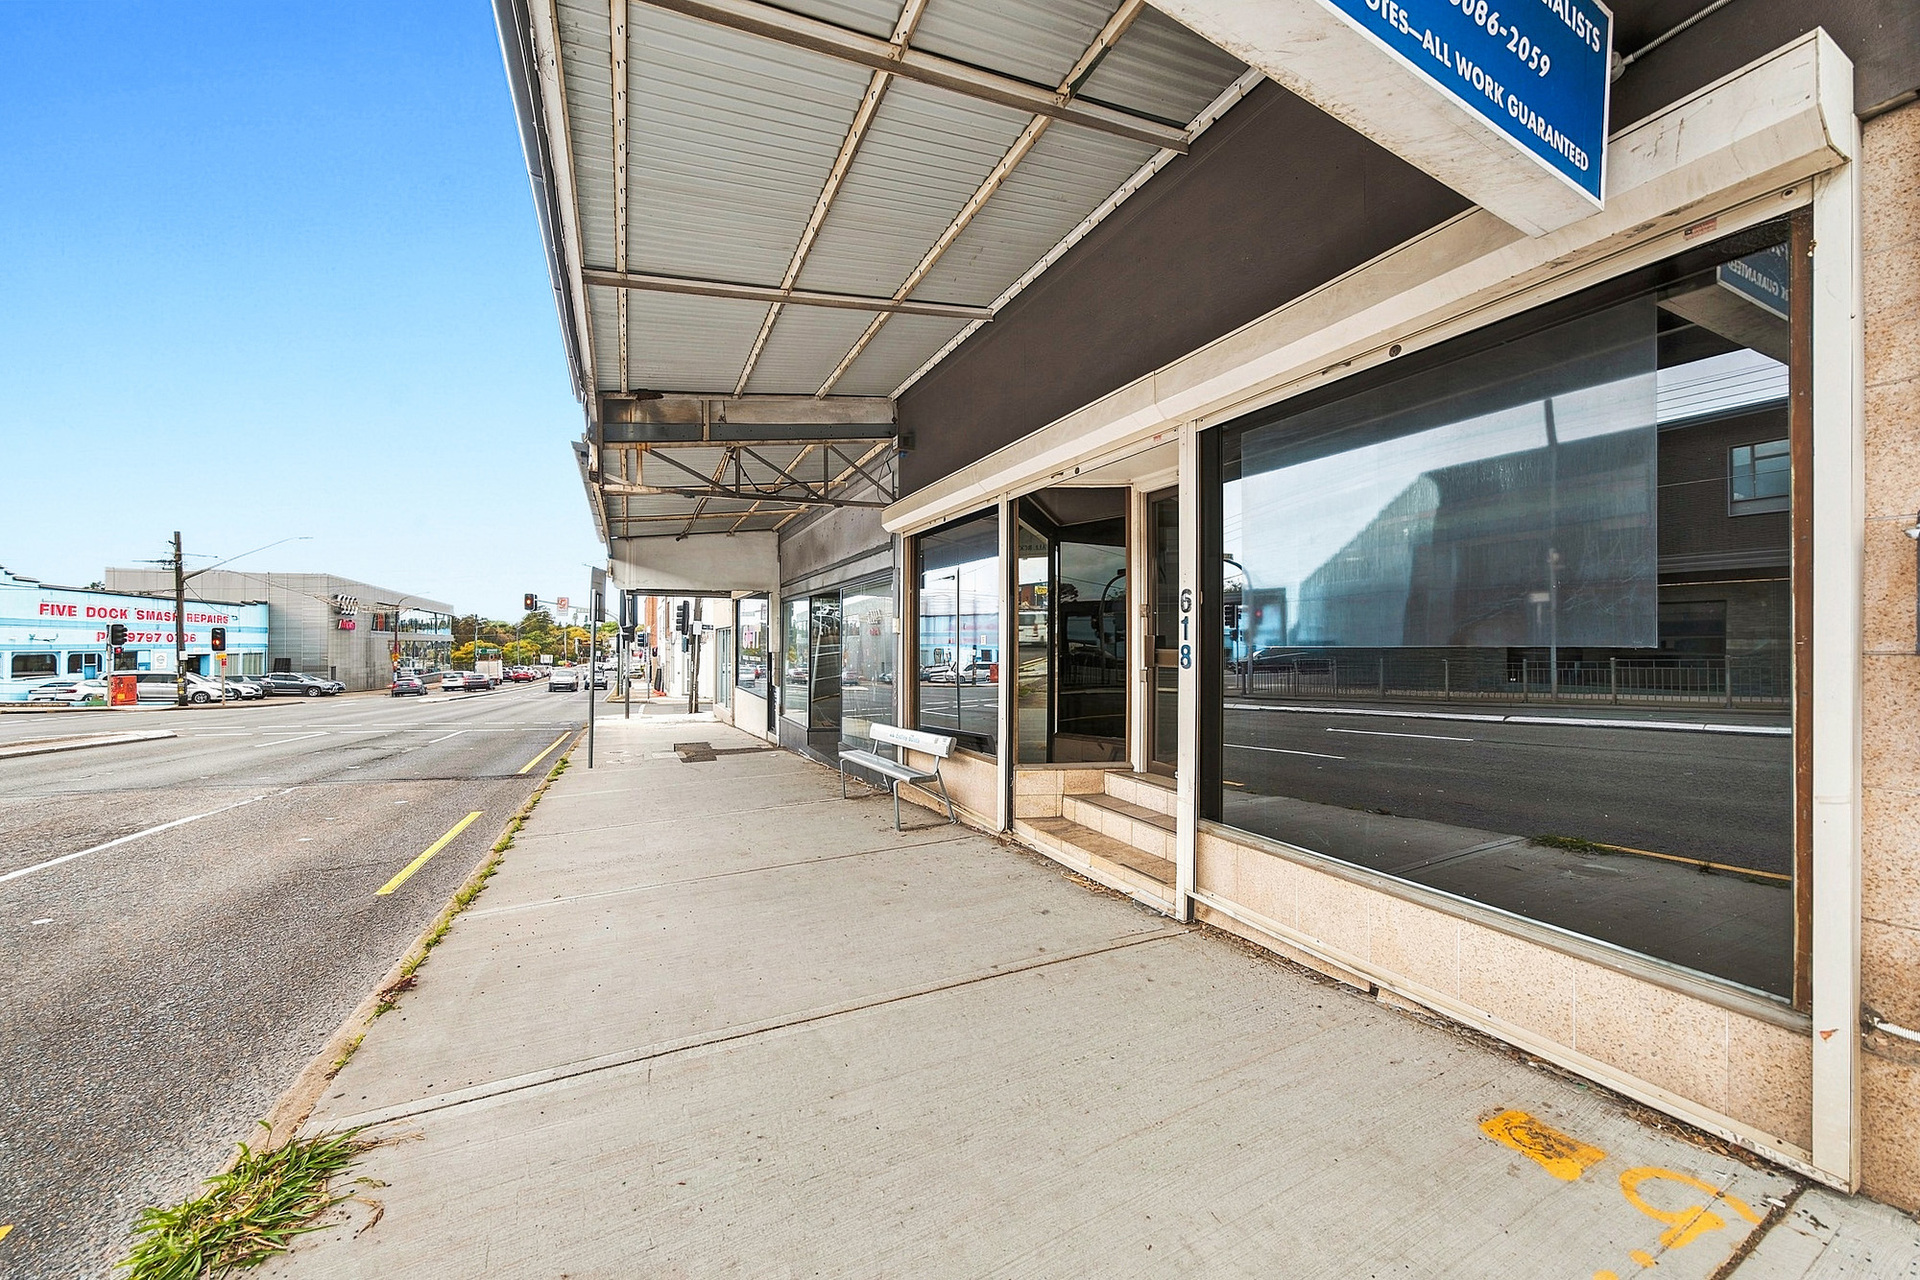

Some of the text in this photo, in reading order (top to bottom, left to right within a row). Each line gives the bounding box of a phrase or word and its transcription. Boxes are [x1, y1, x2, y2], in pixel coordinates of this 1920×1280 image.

[1448, 0, 1551, 78] 086-2059
[1541, 0, 1600, 53] ALISTS
[1455, 51, 1504, 109] WORK
[1507, 94, 1589, 172] GUARANTEED
[39, 603, 78, 617] FIVE
[86, 606, 128, 620] DOCK
[186, 612, 229, 624] REPAIRS
[127, 632, 161, 643] 9797
[166, 633, 197, 643] 006
